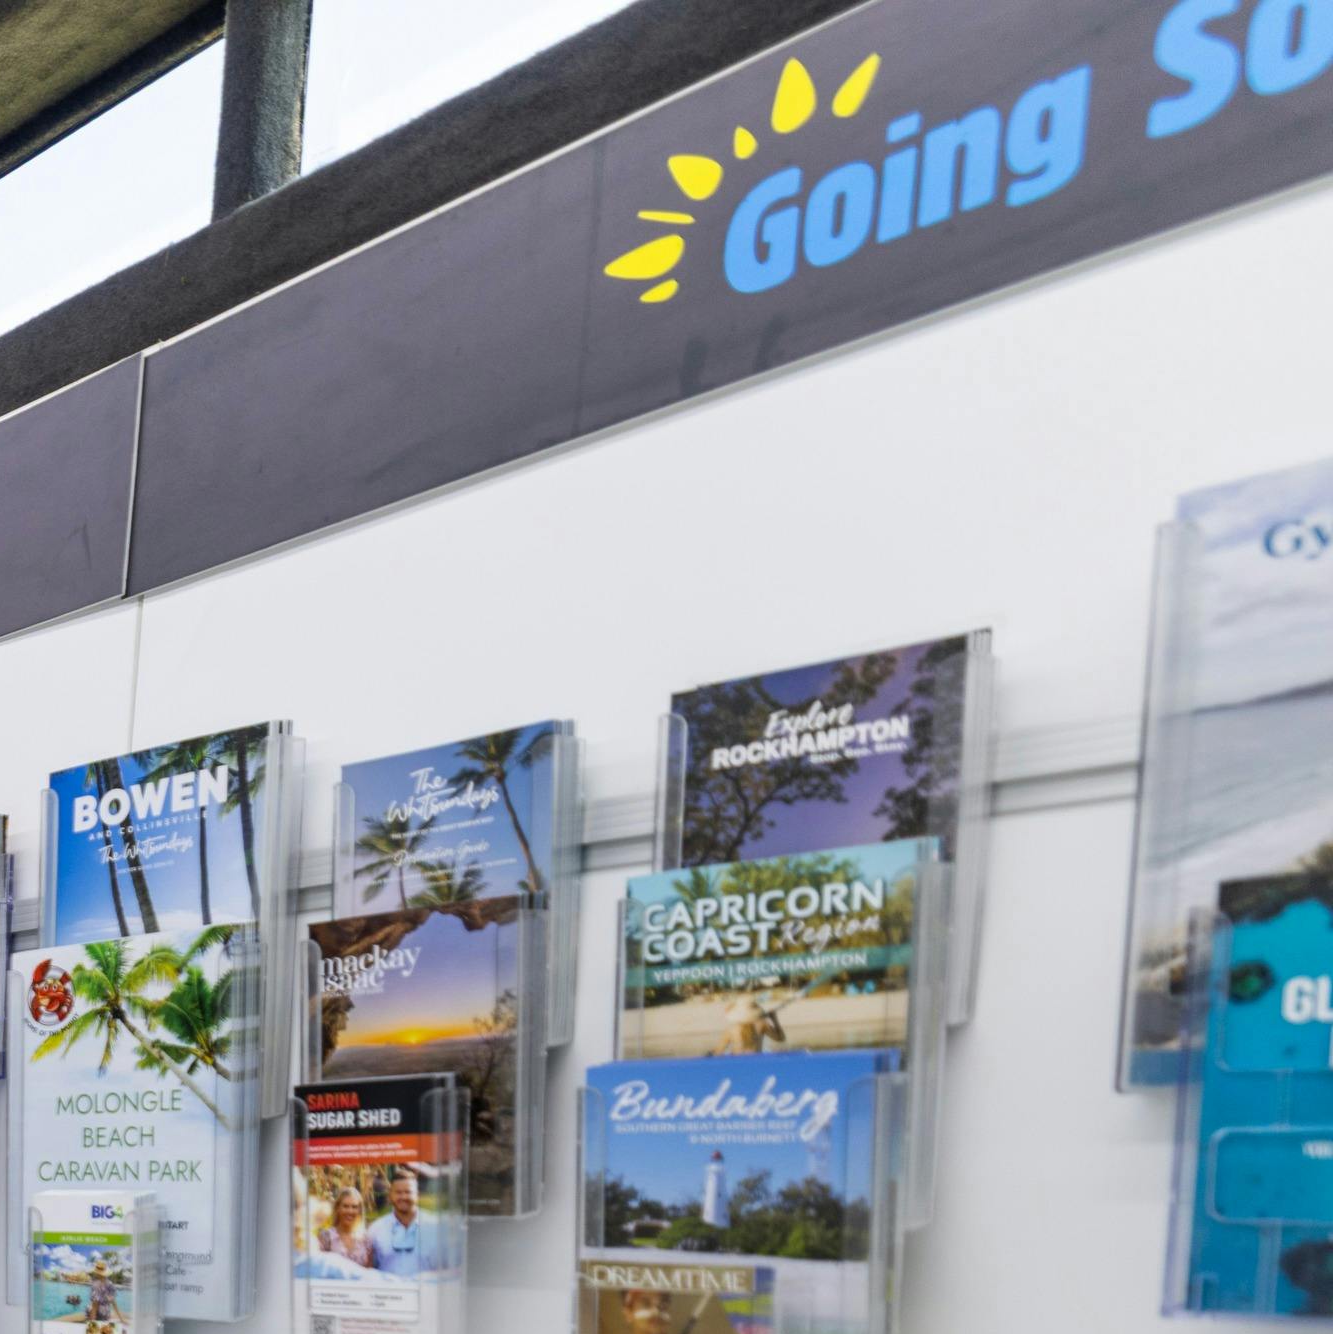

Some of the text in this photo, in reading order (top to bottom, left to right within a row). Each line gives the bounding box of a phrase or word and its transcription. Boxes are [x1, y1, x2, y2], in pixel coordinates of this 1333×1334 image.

[723, 63, 1092, 294] Going
[764, 699, 854, 739] Explore
[711, 715, 910, 771] ROCKHAMPTON
[409, 766, 448, 795] The
[73, 764, 229, 834] BOWEN
[386, 780, 501, 822] Whitsundays
[89, 812, 209, 842] AND COLLINSVILLE
[98, 843, 121, 865] The
[645, 878, 884, 933] CAPRICORN
[643, 913, 881, 964] COAST Region
[321, 943, 422, 977] mackay
[654, 953, 868, 984] YEPPOON ROCKHAMPTON
[321, 966, 386, 993] isaac
[56, 1088, 183, 1116] MOLONGLE
[307, 1090, 361, 1110] SARINA
[610, 1075, 839, 1142] Bundaberg
[308, 1108, 402, 1129] SUGAR SHED
[82, 1126, 156, 1149] BEACH
[38, 1159, 203, 1183] CARAVAN PARK
[91, 1204, 124, 1219] BIG4
[593, 1263, 748, 1292] DREAMTIME
